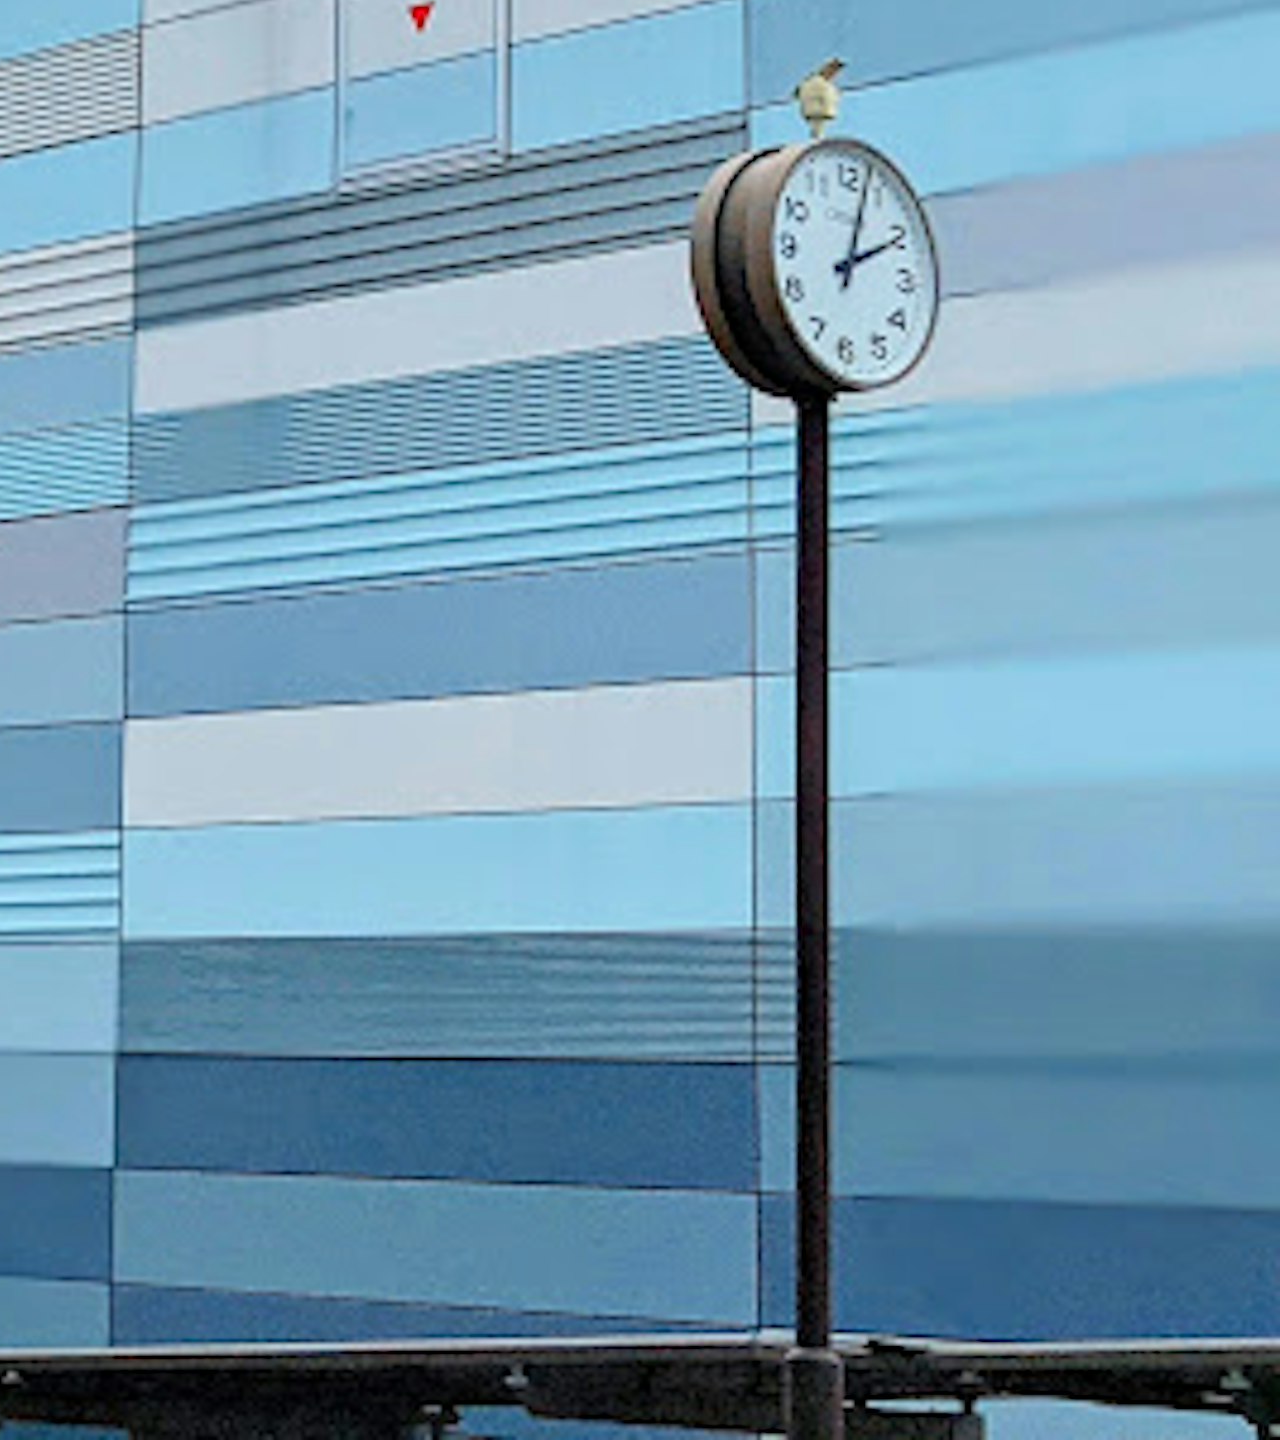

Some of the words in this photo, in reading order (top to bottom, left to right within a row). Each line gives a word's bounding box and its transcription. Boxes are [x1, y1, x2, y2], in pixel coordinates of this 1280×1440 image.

[805, 168, 829, 198] 11
[837, 163, 858, 192] 12
[785, 196, 810, 223] 10
[780, 231, 796, 259] 9
[889, 224, 907, 250] 2
[785, 275, 805, 302] 8
[896, 267, 915, 294] 3
[808, 316, 826, 341] 7
[886, 308, 907, 332] 4
[836, 335, 854, 364] 6
[870, 333, 887, 360] 5
